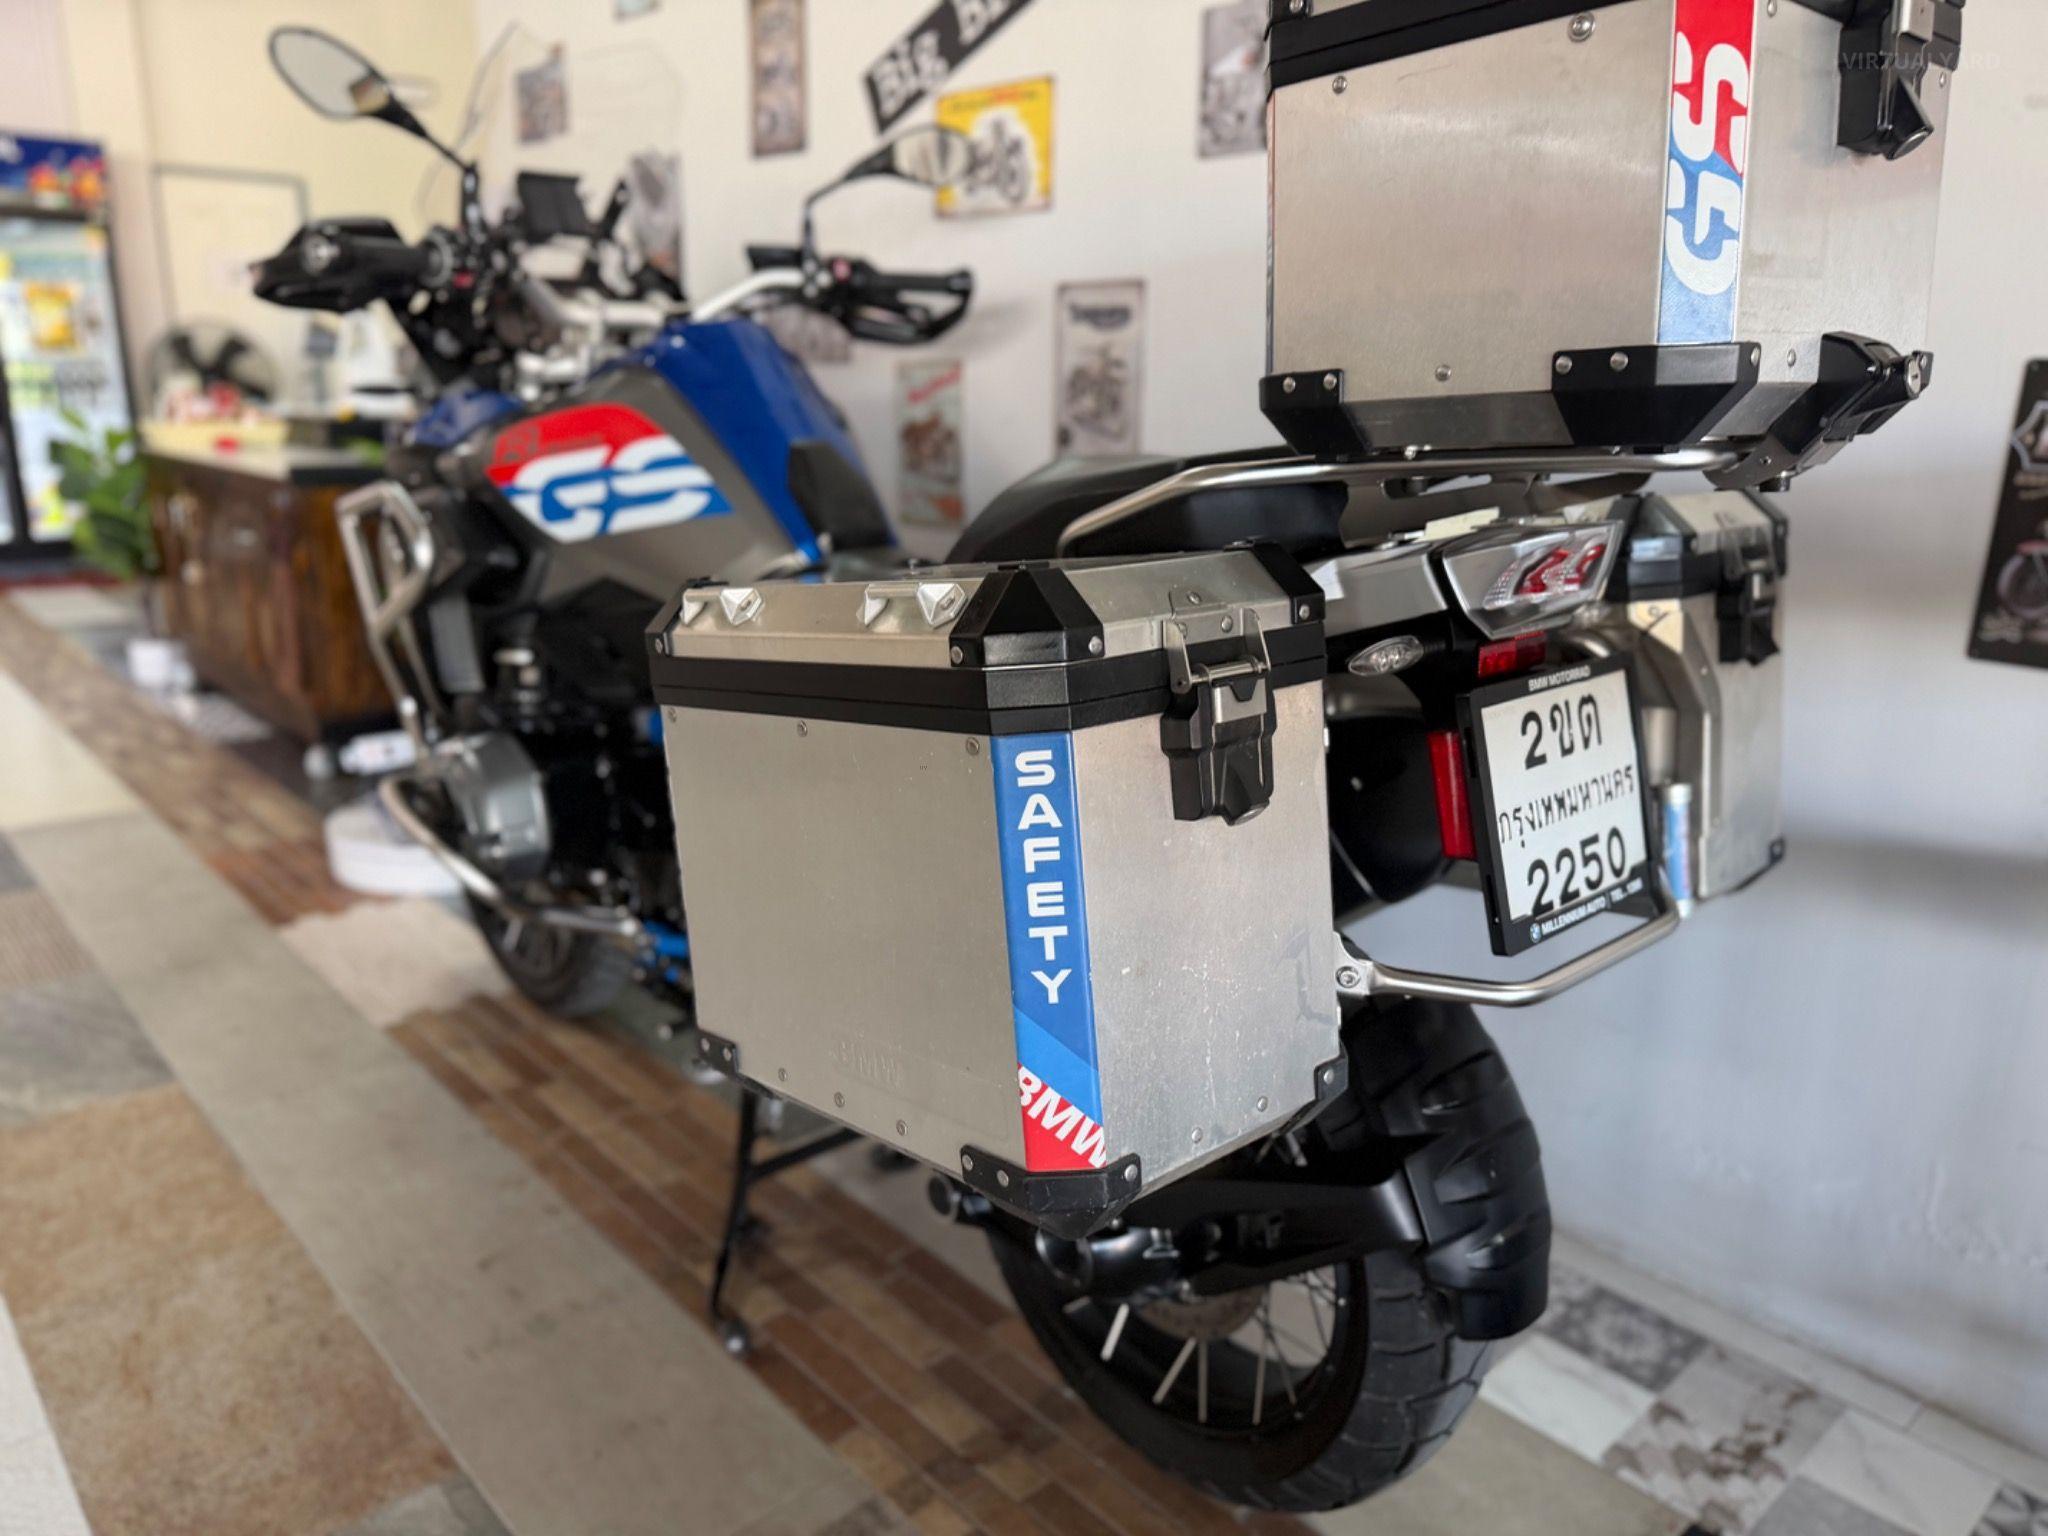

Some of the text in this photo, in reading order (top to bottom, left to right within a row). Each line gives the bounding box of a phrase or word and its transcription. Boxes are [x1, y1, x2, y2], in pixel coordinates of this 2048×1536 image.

[1665, 30, 1750, 296] GS
[509, 433, 712, 544] GS
[1528, 665, 1591, 692] BMW MOTORRAD
[1499, 765, 1634, 849] กรุงเทพมหานคร
[1015, 749, 1072, 1005] SAFETY
[1527, 827, 1626, 916] 2250
[1018, 1066, 1106, 1169] BMW
